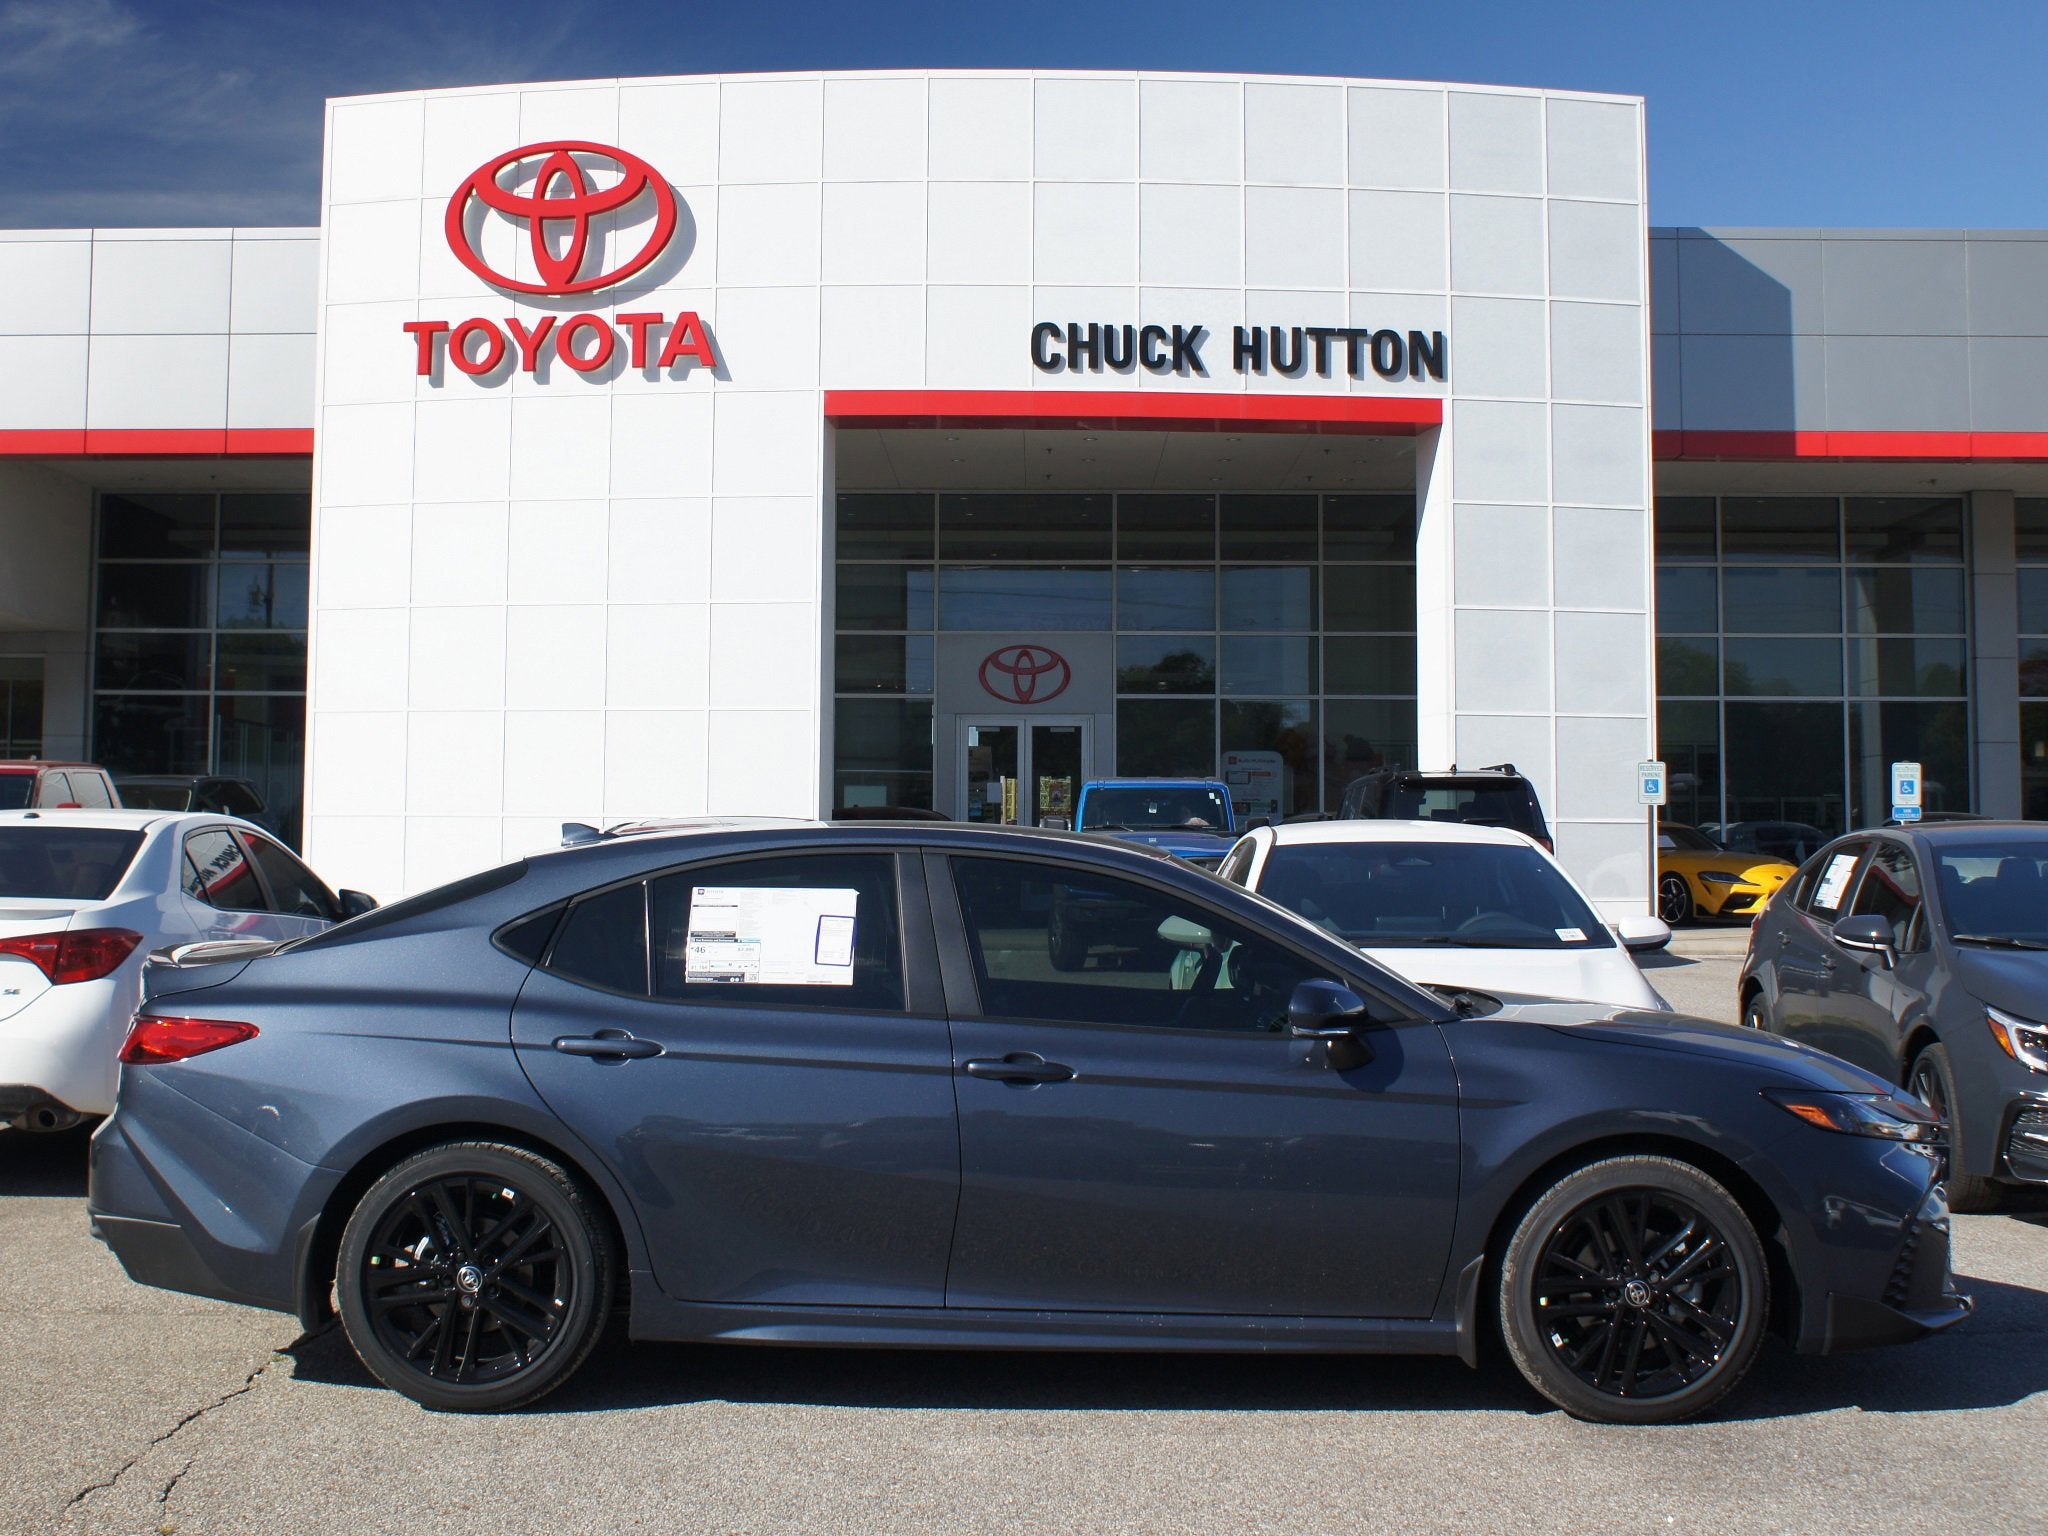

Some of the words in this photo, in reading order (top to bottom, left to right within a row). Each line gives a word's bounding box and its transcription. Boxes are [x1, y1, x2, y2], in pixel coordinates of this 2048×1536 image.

[403, 311, 717, 376] TOYOTA
[1030, 321, 1204, 372] CHUCK
[1232, 325, 1443, 379] HUTTON
